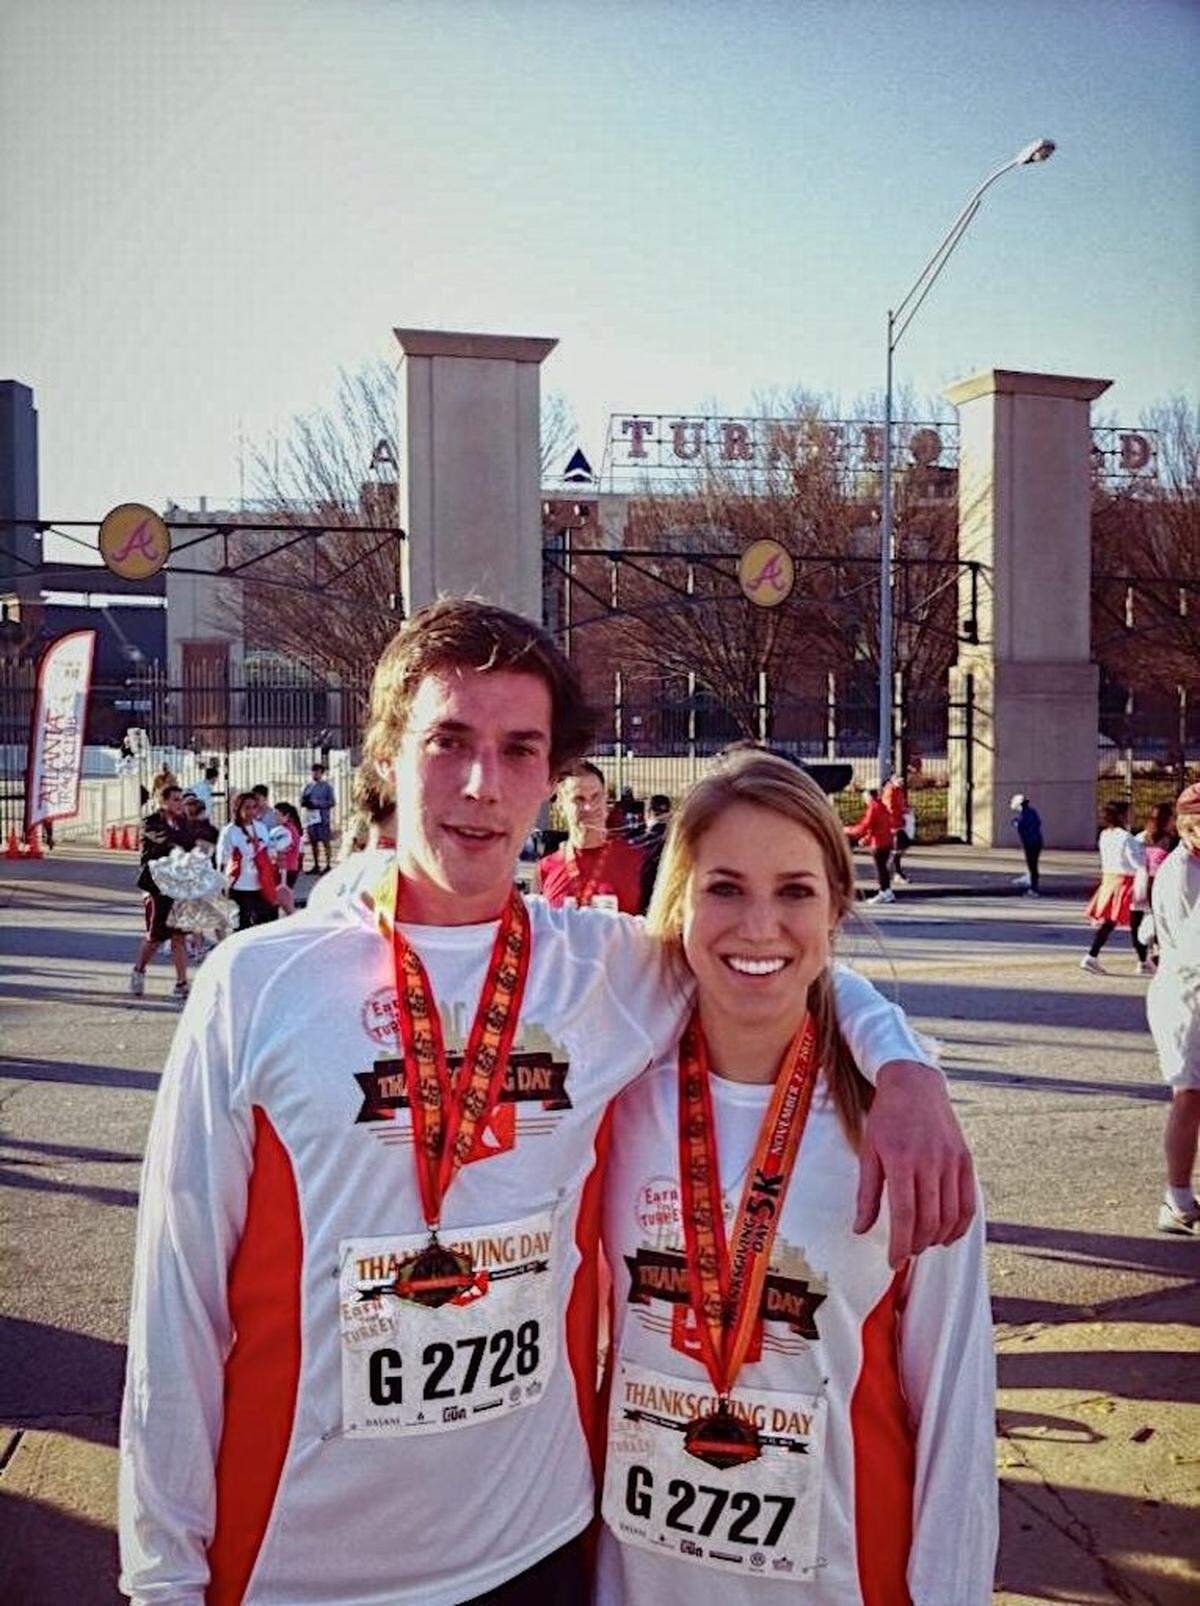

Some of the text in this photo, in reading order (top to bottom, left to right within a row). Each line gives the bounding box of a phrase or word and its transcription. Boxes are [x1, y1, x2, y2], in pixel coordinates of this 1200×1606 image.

[517, 1066, 550, 1091] DAY
[746, 1168, 784, 1220] 5K
[520, 1231, 552, 1259] DAY
[767, 1287, 804, 1315] DAY
[369, 1319, 540, 1406] G 2728
[772, 1408, 815, 1436] DAY
[626, 1465, 796, 1547] G 2727
